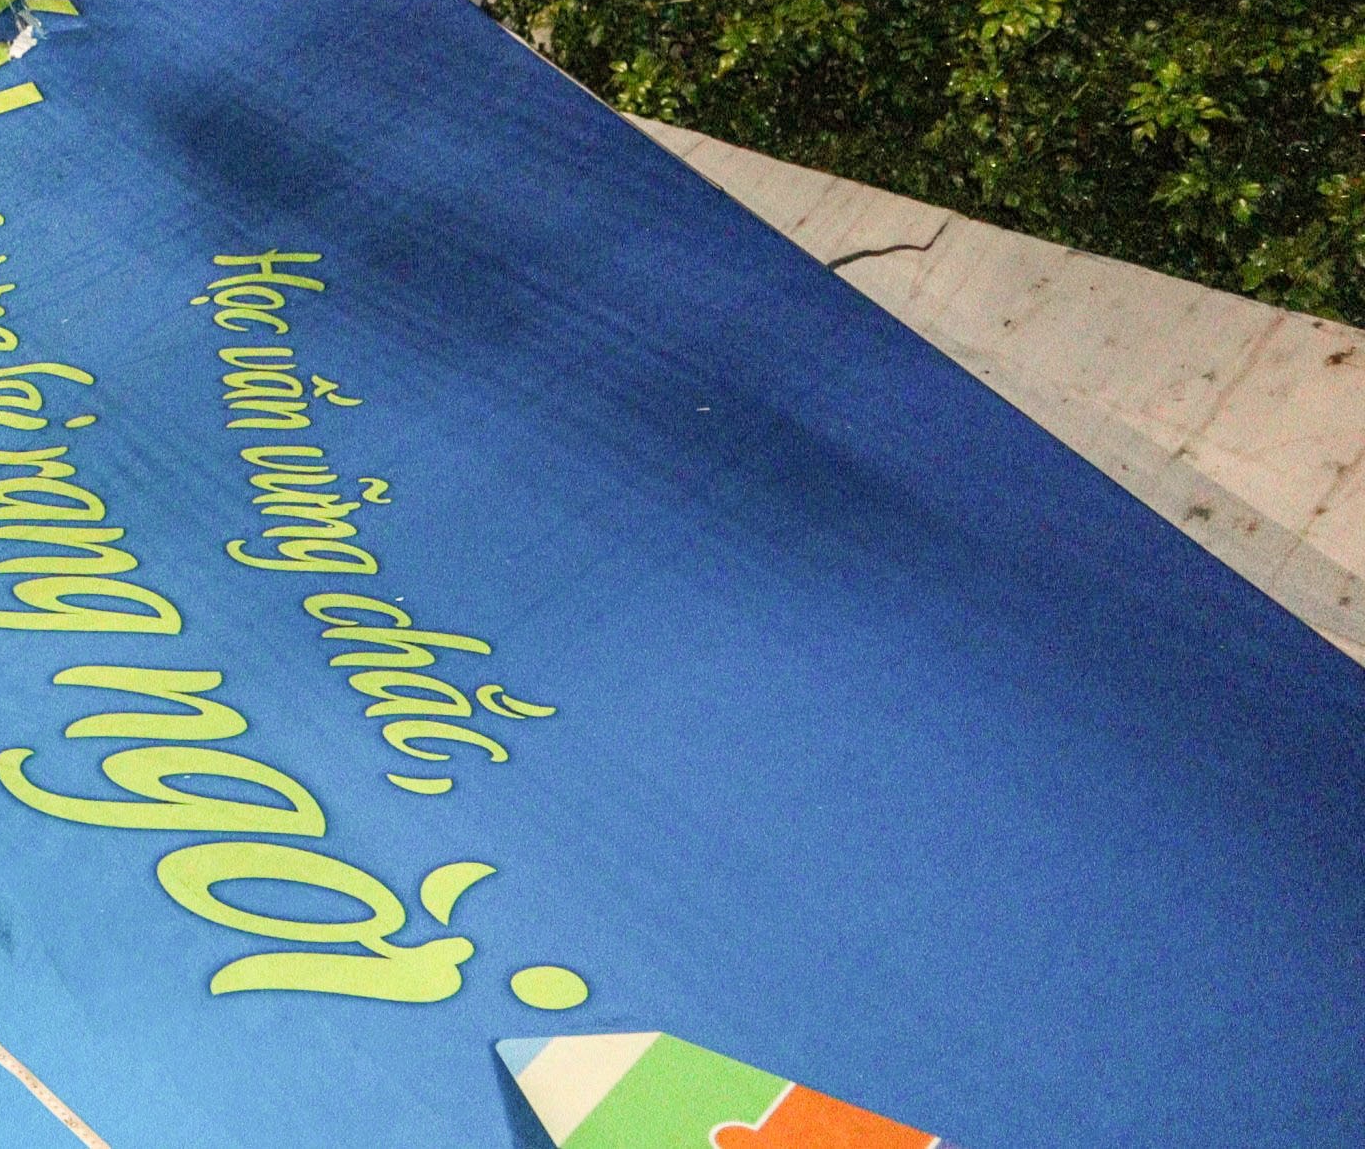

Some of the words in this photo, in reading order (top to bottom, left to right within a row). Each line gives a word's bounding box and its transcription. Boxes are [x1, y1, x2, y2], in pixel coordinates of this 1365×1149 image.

[190, 249, 325, 335] Học
[218, 346, 363, 430] vấn
[225, 445, 392, 576] vững
[302, 592, 557, 795] chắc,
